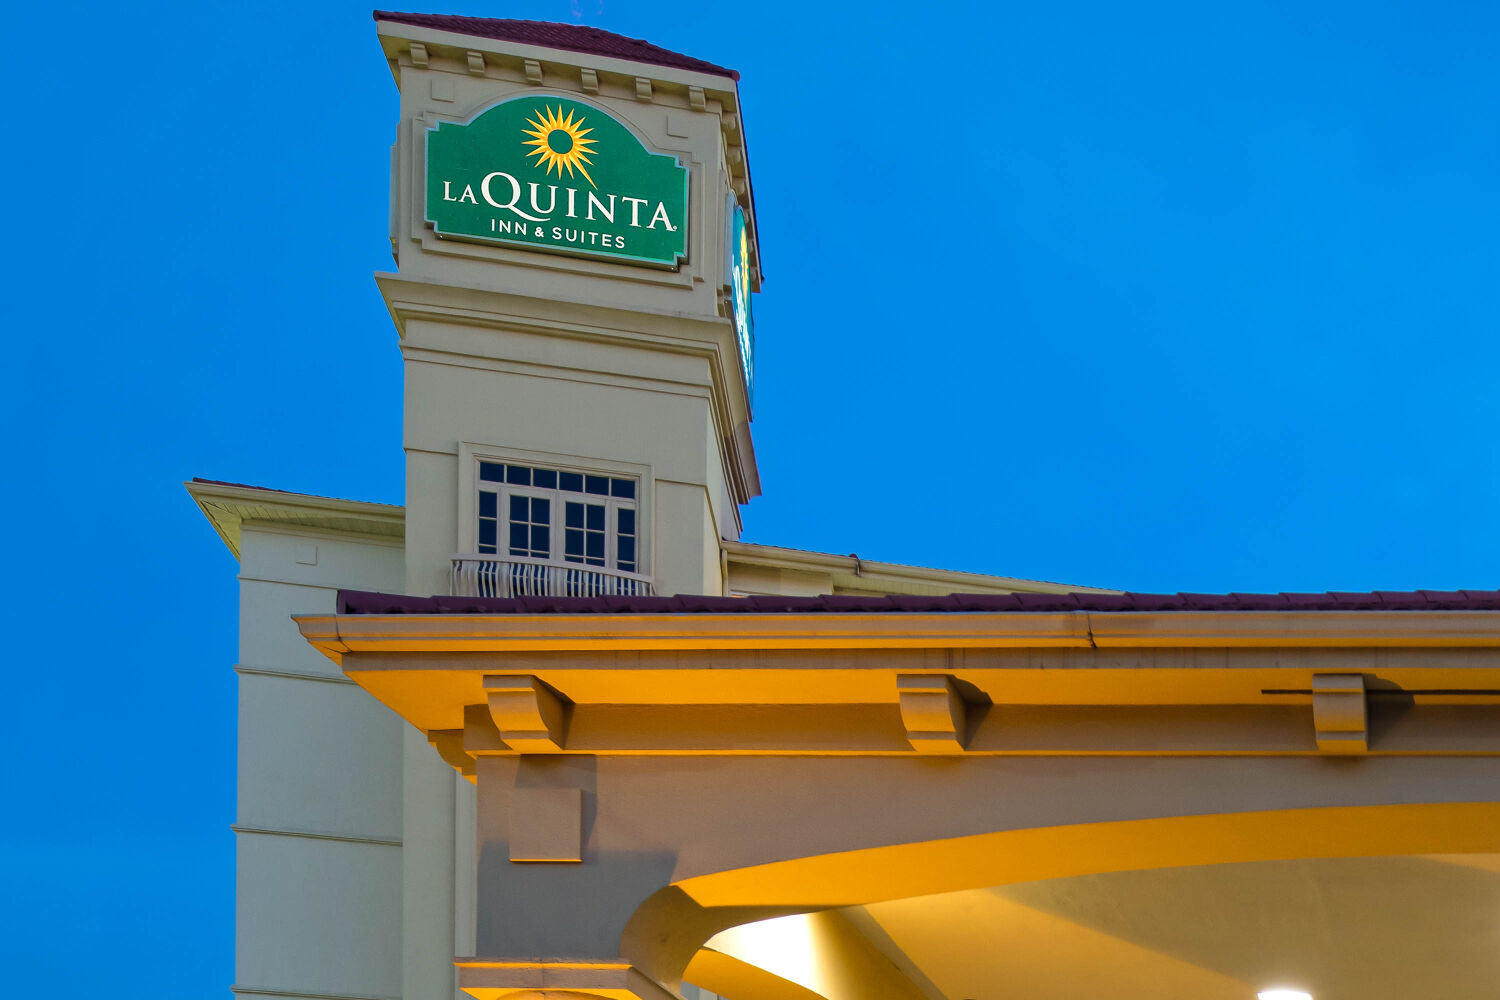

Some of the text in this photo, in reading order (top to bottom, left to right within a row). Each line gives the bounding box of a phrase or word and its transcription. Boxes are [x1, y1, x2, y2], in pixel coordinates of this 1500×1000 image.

[443, 172, 677, 232] LA QUINTA
[491, 218, 625, 249] INN & SUITES
